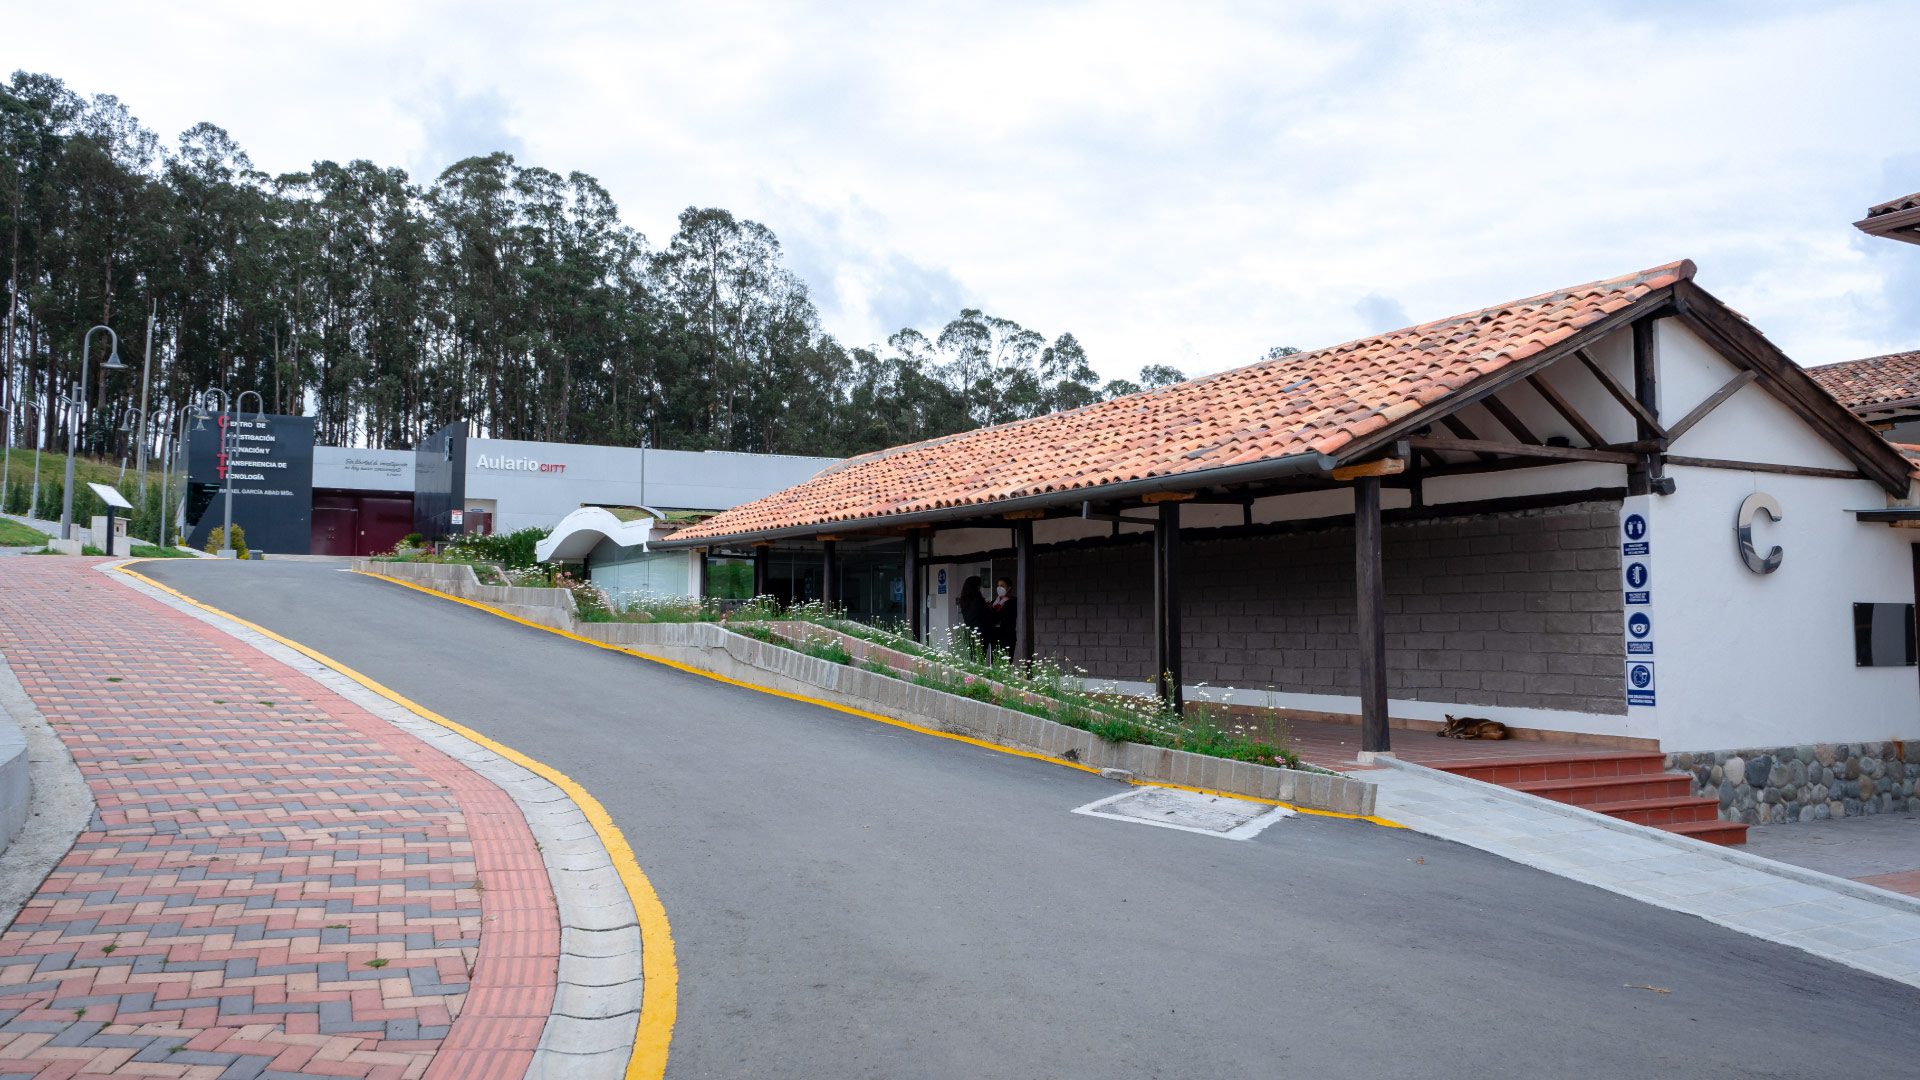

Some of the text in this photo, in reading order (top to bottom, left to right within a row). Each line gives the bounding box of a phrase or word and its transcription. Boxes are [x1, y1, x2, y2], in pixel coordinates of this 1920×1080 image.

[221, 428, 275, 442] ISTIGACIÓN
[476, 454, 566, 473] Aulario CIITT
[1737, 492, 1783, 575] C
